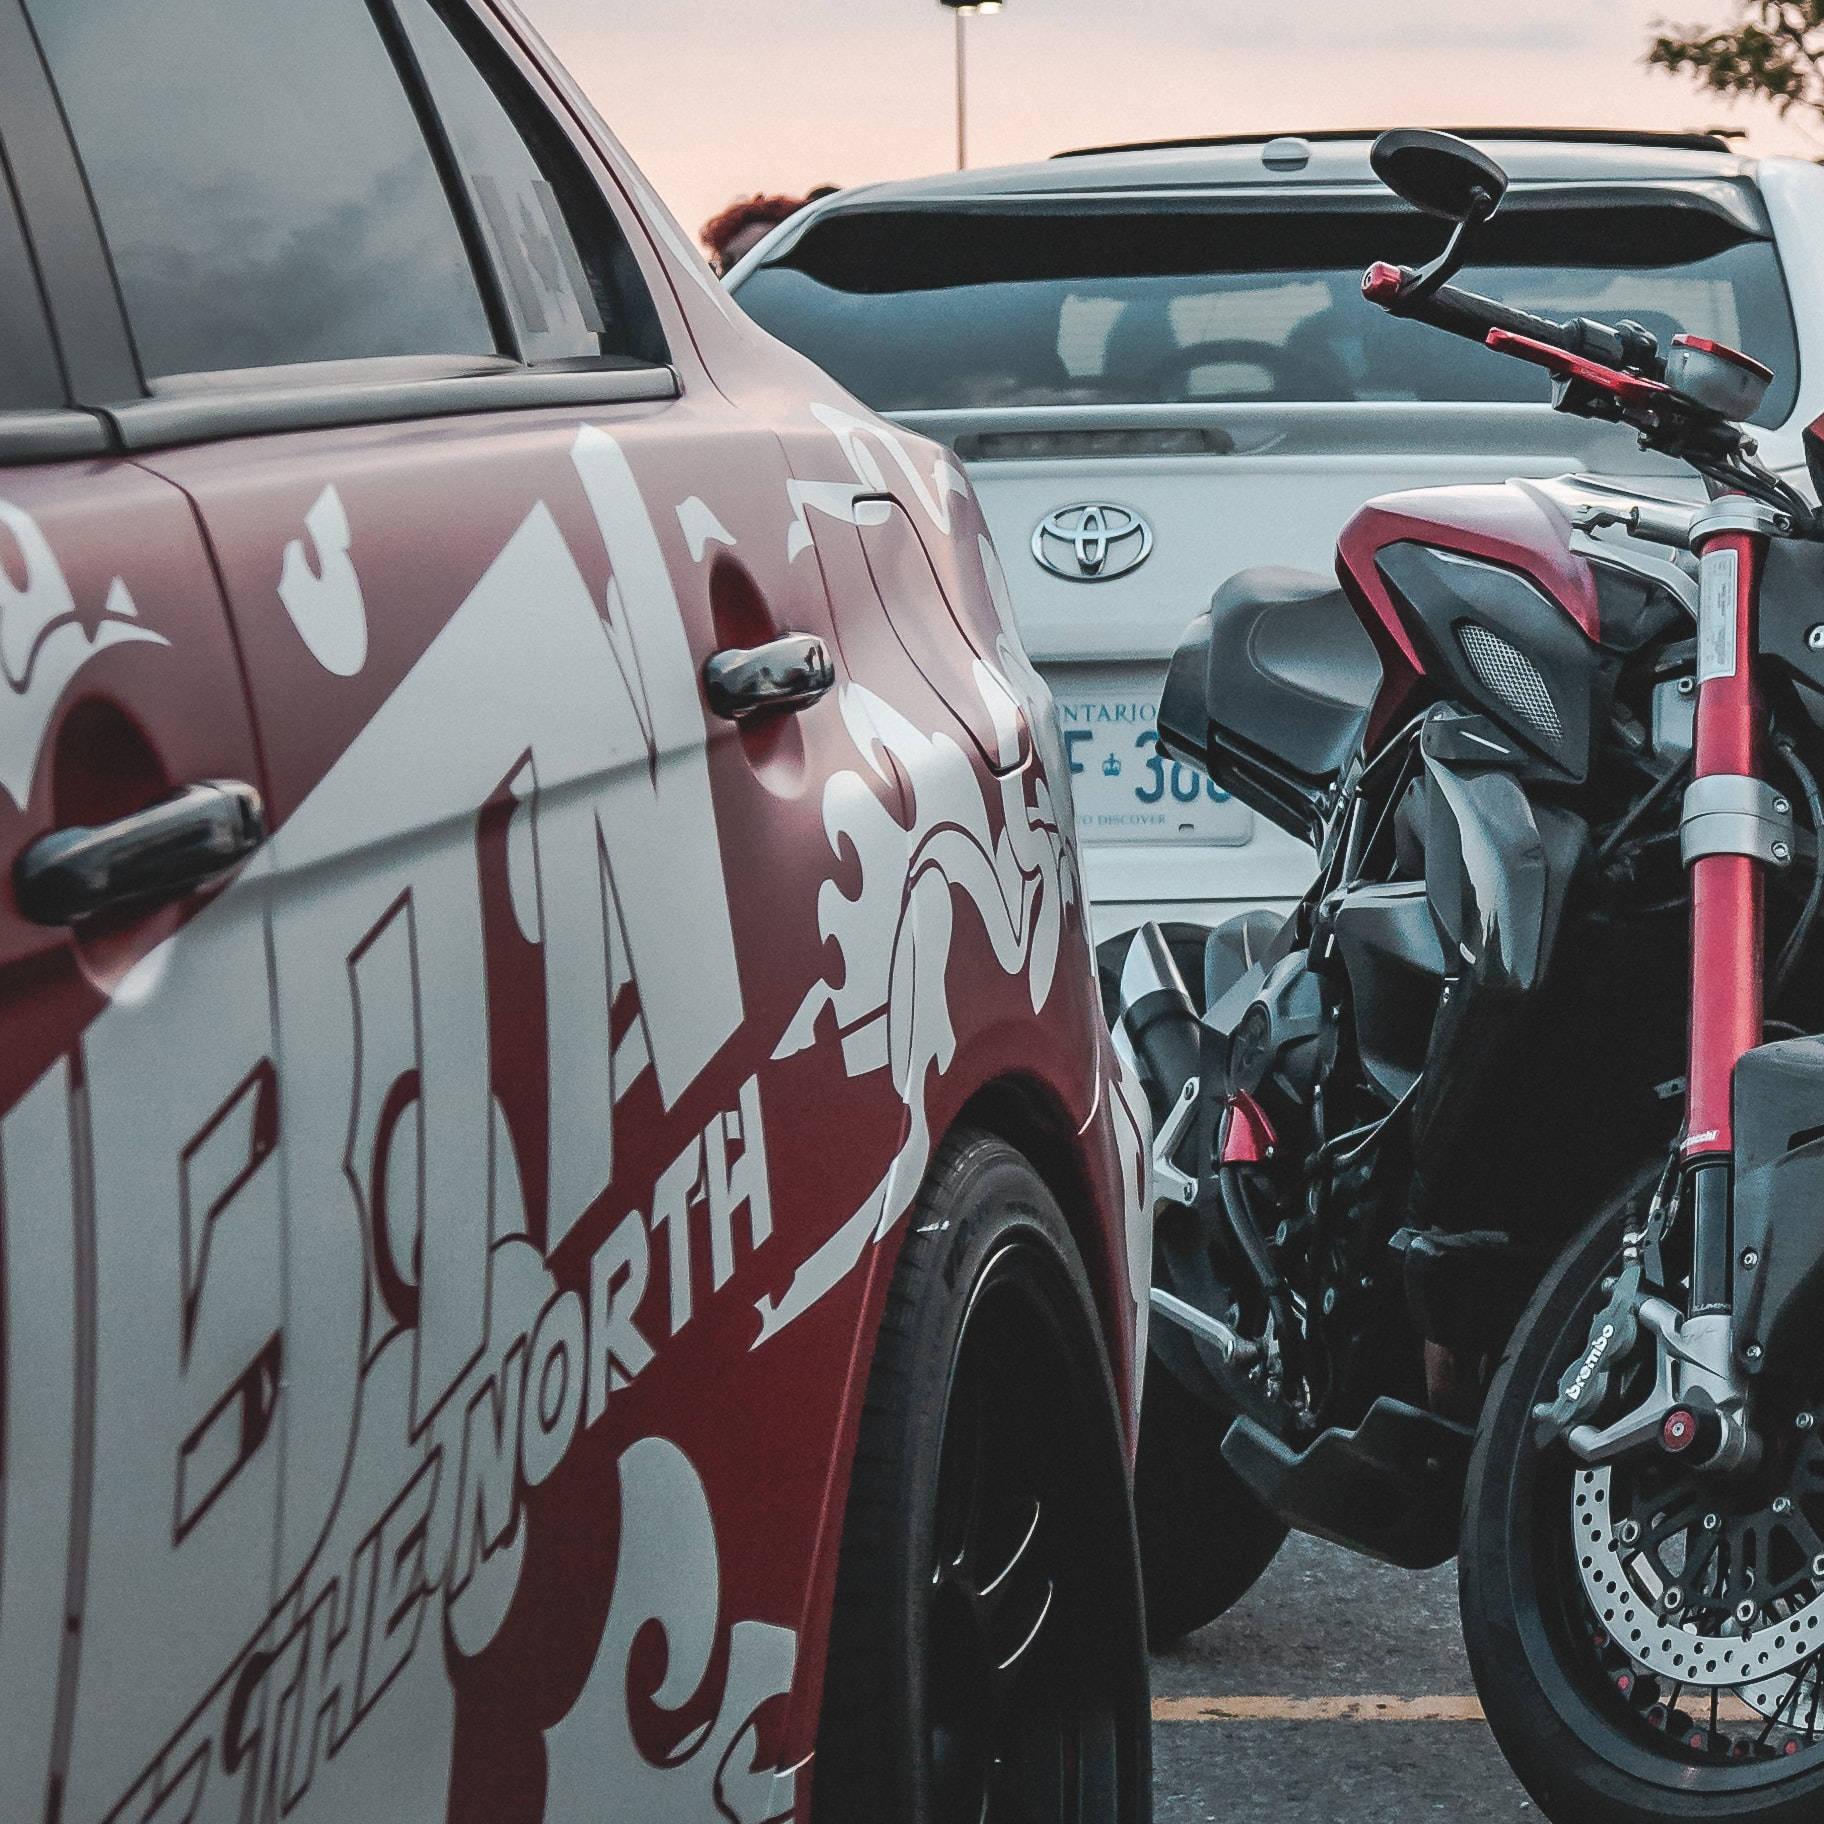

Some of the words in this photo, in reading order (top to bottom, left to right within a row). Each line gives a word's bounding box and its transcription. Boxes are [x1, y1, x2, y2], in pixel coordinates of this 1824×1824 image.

[1062, 703, 1157, 723] NTARIO
[1097, 814, 1166, 825] DISCOVER
[1565, 1324, 1614, 1401] brembo
[232, 1441, 443, 1818] THE
[446, 1073, 773, 1604] NORTH
